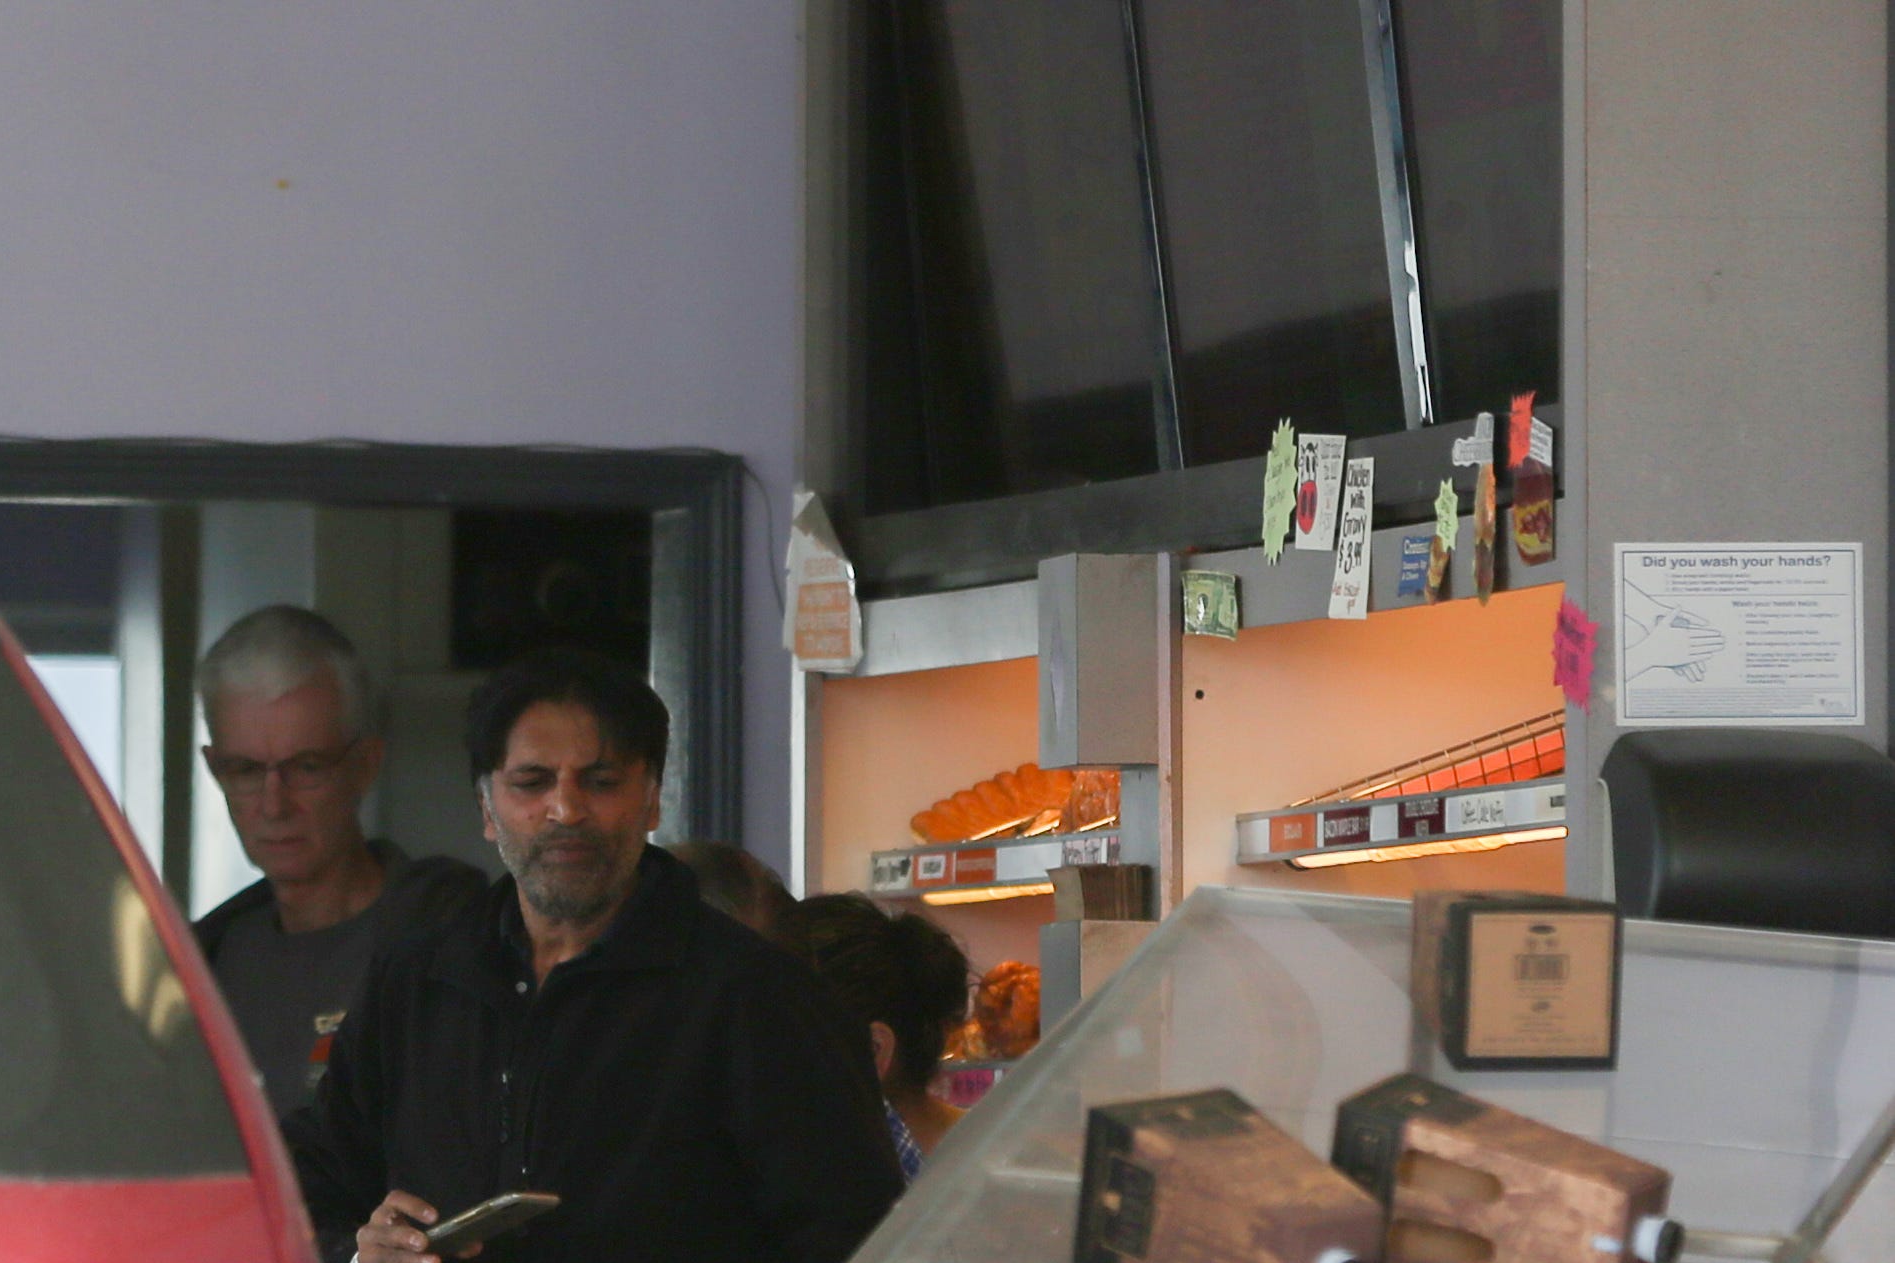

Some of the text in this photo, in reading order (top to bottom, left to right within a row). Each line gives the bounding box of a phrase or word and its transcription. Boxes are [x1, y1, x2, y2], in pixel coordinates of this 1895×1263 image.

[1346, 463, 1371, 487] Chicken
[1350, 489, 1365, 509] with
[1342, 511, 1367, 545] Gravy
[1642, 555, 1832, 570] Did you wash your hands?
